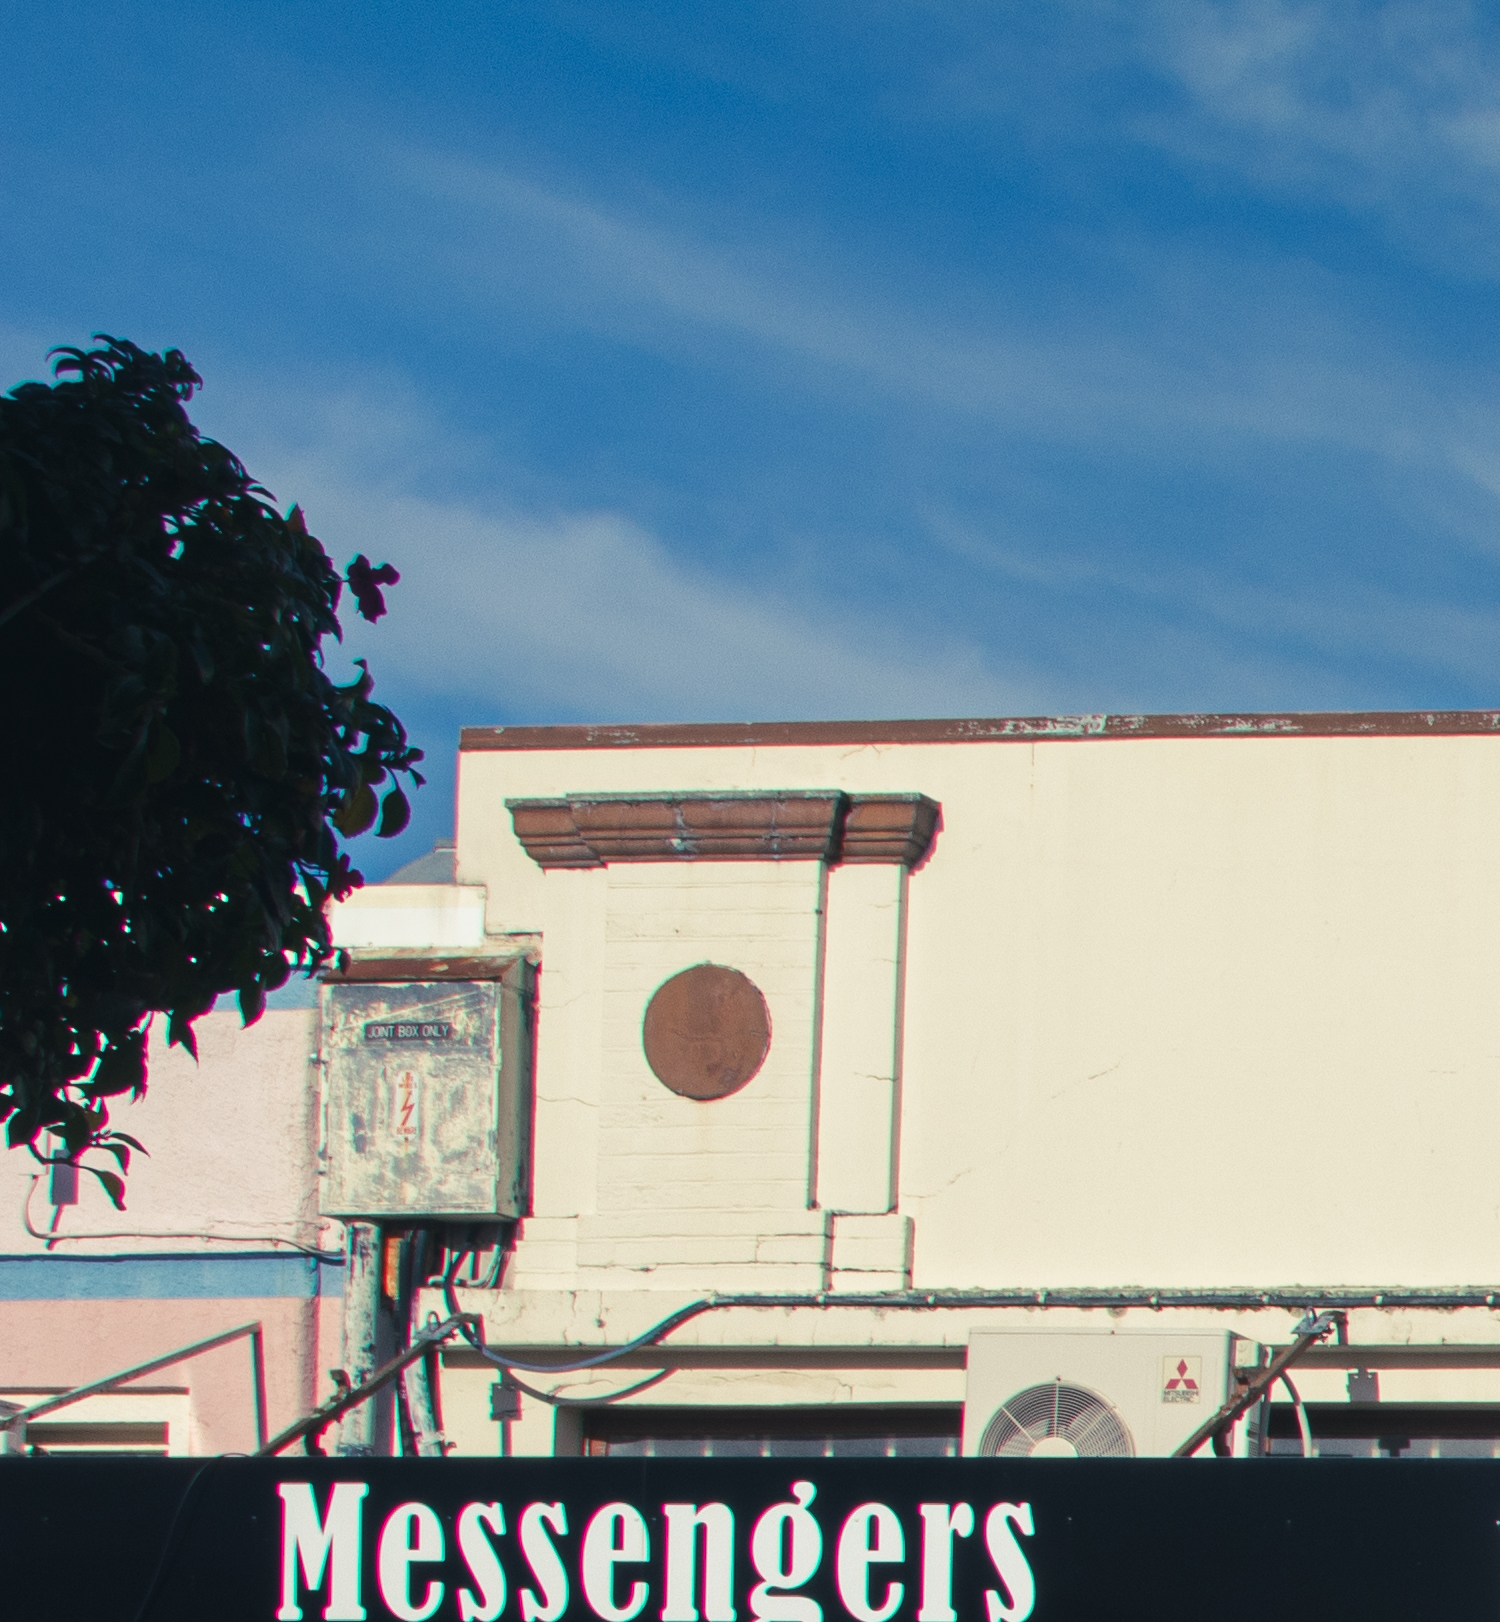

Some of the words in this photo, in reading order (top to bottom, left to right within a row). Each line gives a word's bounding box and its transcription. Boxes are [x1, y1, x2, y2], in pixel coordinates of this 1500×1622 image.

[367, 1025, 395, 1039] JOINT
[398, 1025, 420, 1039] BOX
[422, 1025, 450, 1039] ONLY
